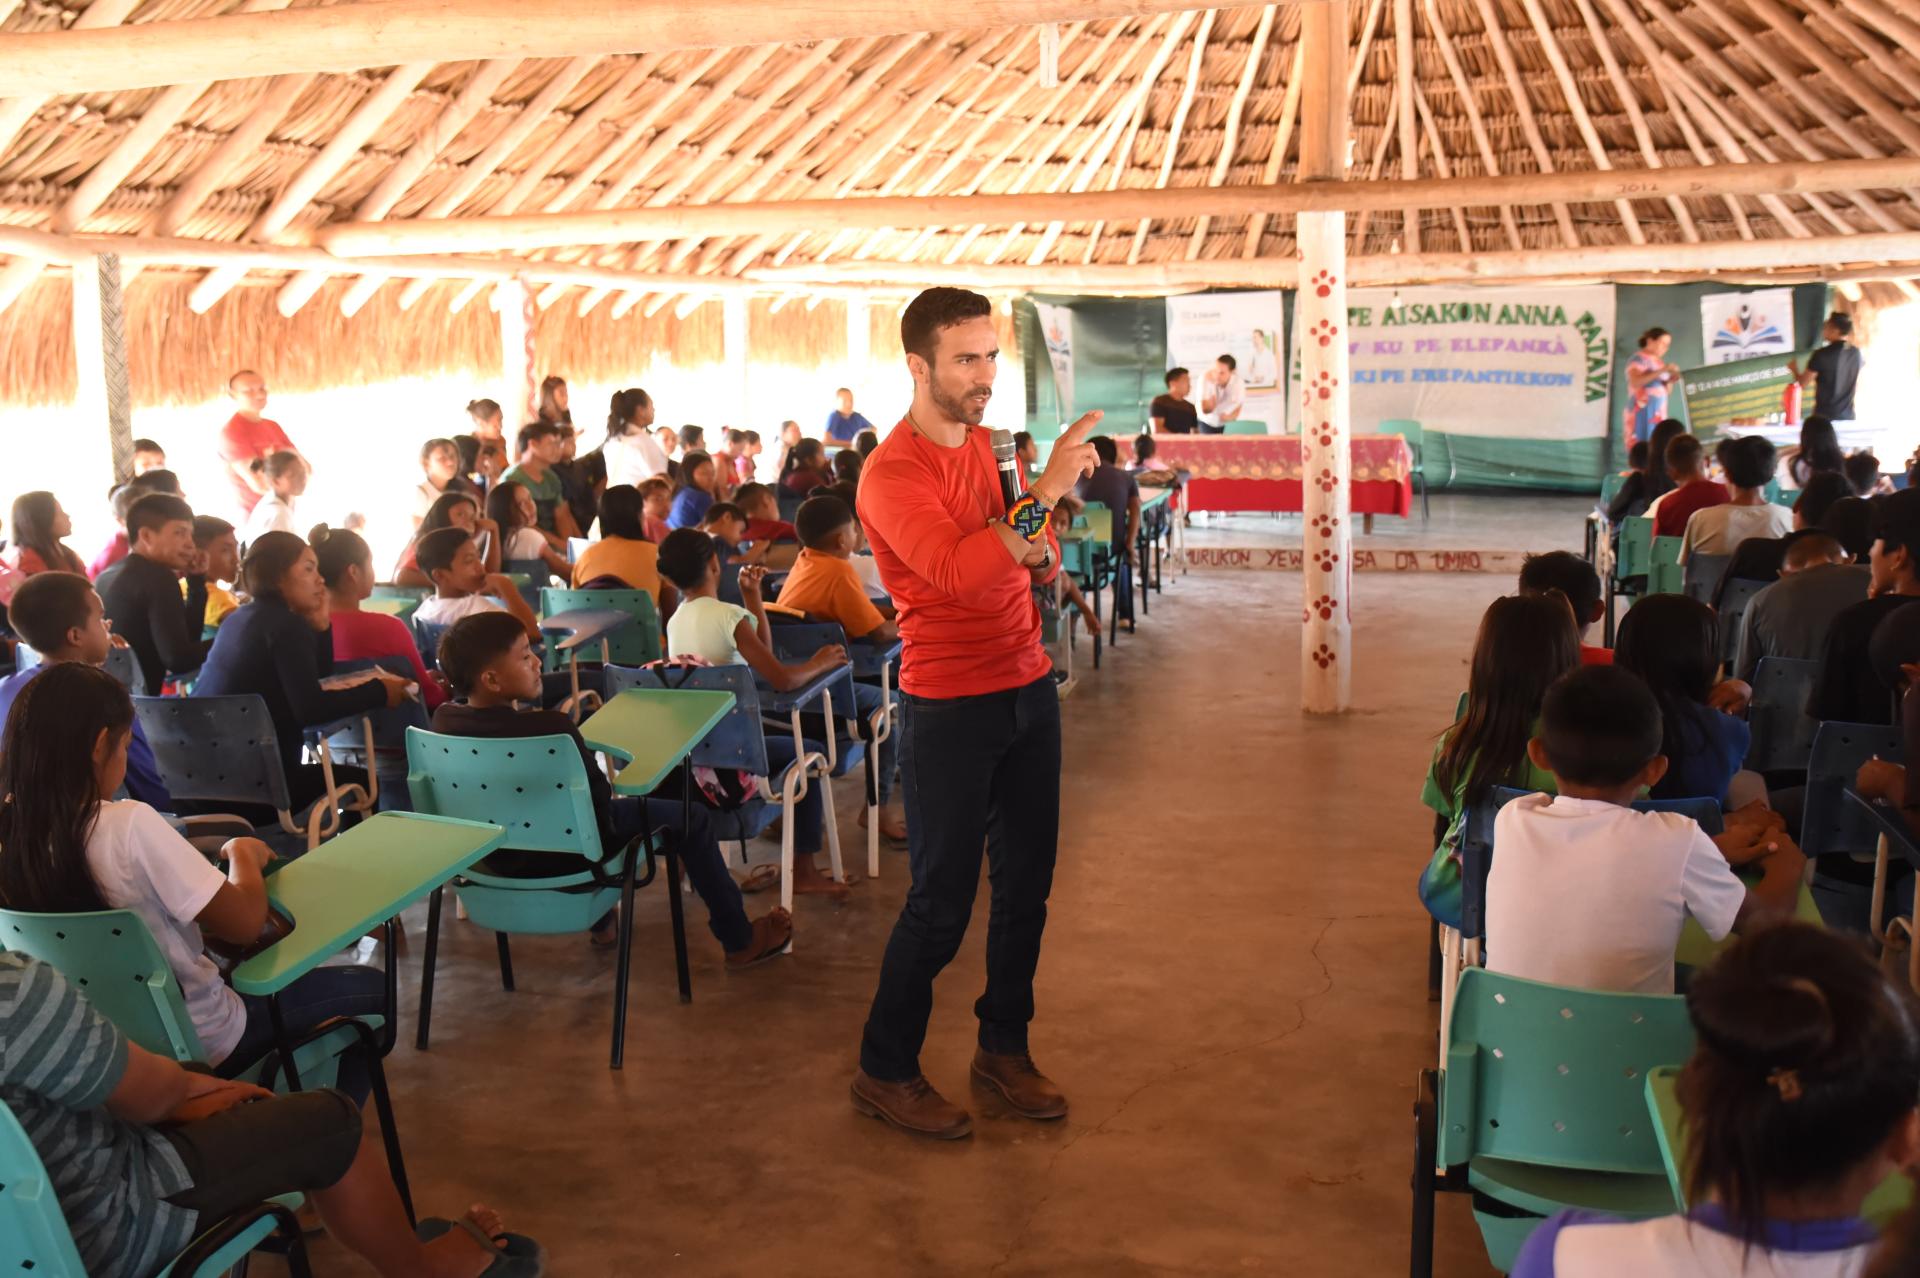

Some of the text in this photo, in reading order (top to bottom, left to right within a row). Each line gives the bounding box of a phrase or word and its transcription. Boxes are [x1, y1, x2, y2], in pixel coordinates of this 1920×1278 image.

[1414, 338, 1439, 353] PE
[1495, 303, 1568, 326] ANNA
[1573, 310, 1609, 403] PATAYA
